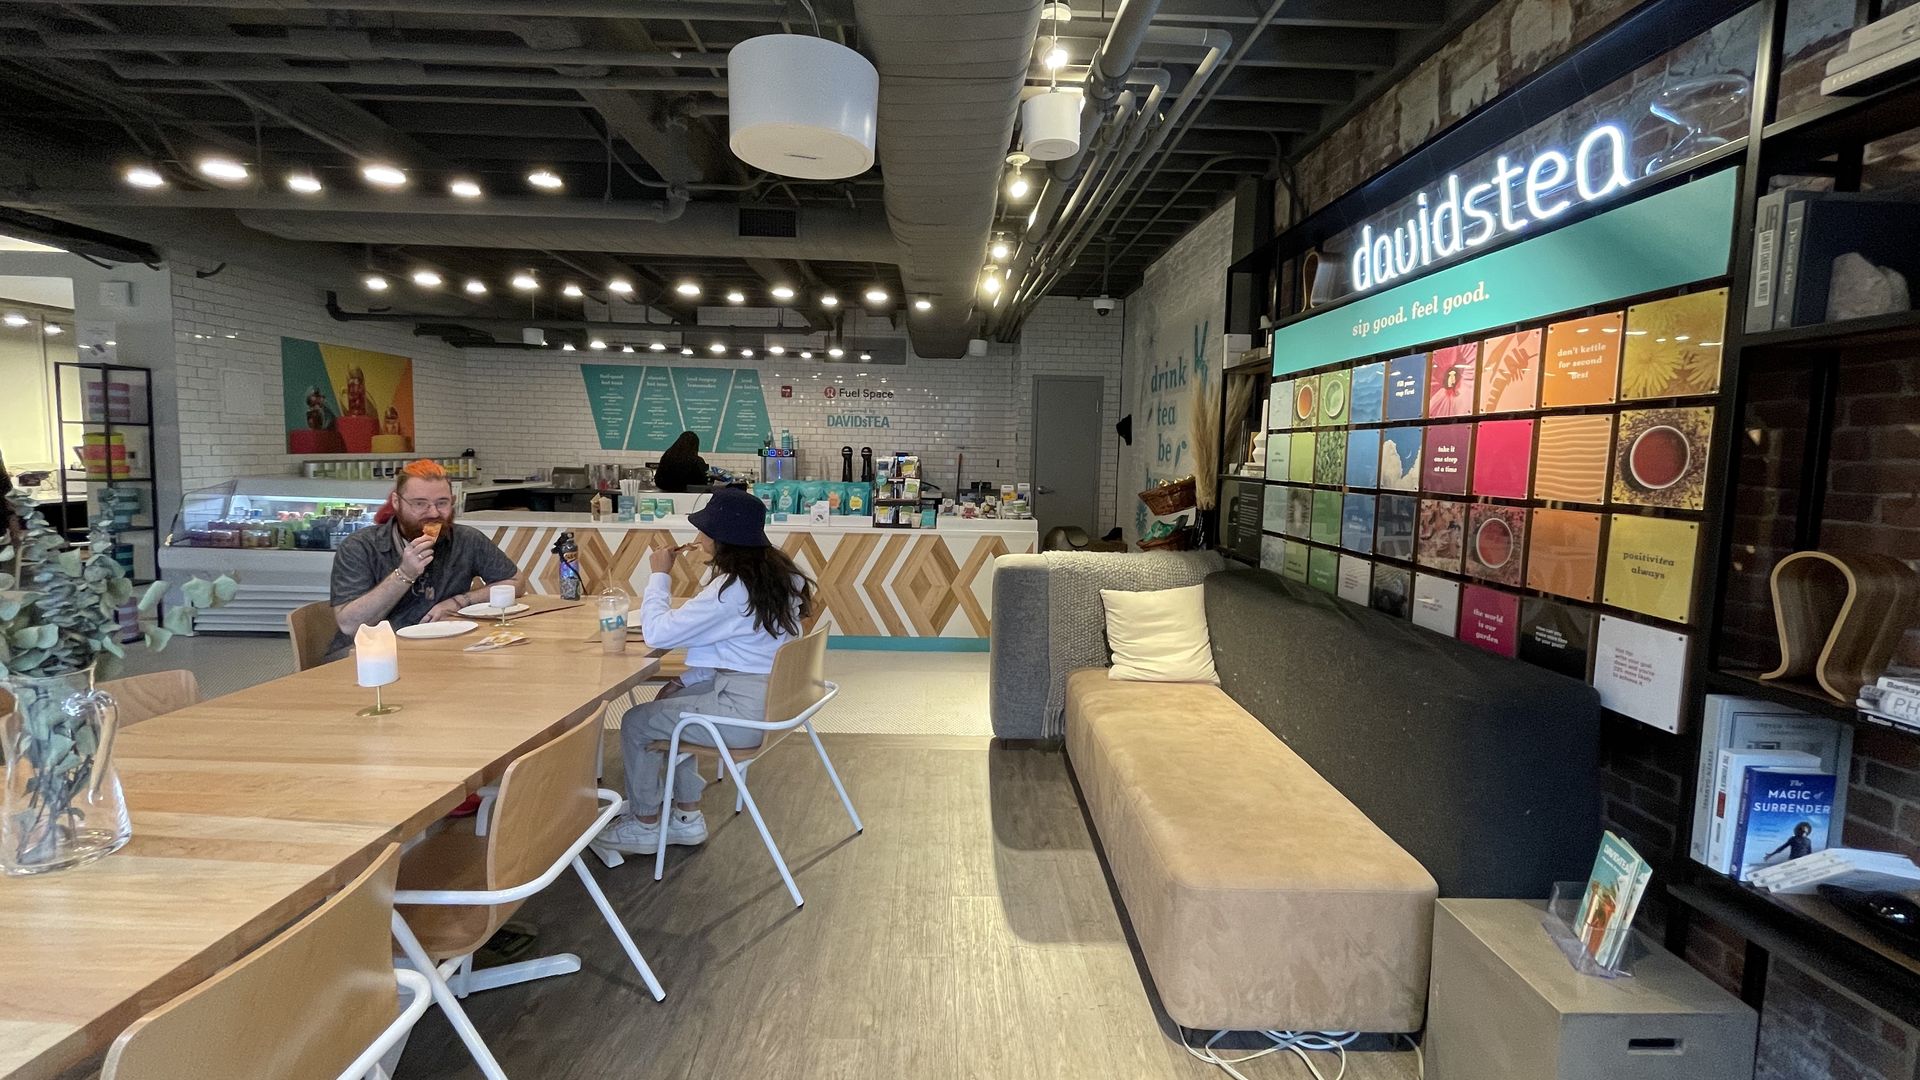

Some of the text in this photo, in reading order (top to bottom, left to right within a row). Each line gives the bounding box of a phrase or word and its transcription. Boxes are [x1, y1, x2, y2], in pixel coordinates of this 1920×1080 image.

[1352, 124, 1633, 292] davidstea
[1352, 281, 1490, 338] sip good. feel good.
[1557, 342, 1606, 357] don't kettle
[1558, 355, 1602, 369] for second
[1151, 356, 1187, 393] drink
[839, 388, 894, 400] Fuel Space
[1157, 401, 1176, 426] tea
[1158, 433, 1172, 462] be
[1623, 552, 1675, 566] positivitea
[1631, 566, 1665, 580] always
[1473, 608, 1504, 623] the world
[1475, 632, 1499, 645] garden
[1768, 789, 1812, 800] MAGIC
[1752, 802, 1831, 815] SURRENDER
